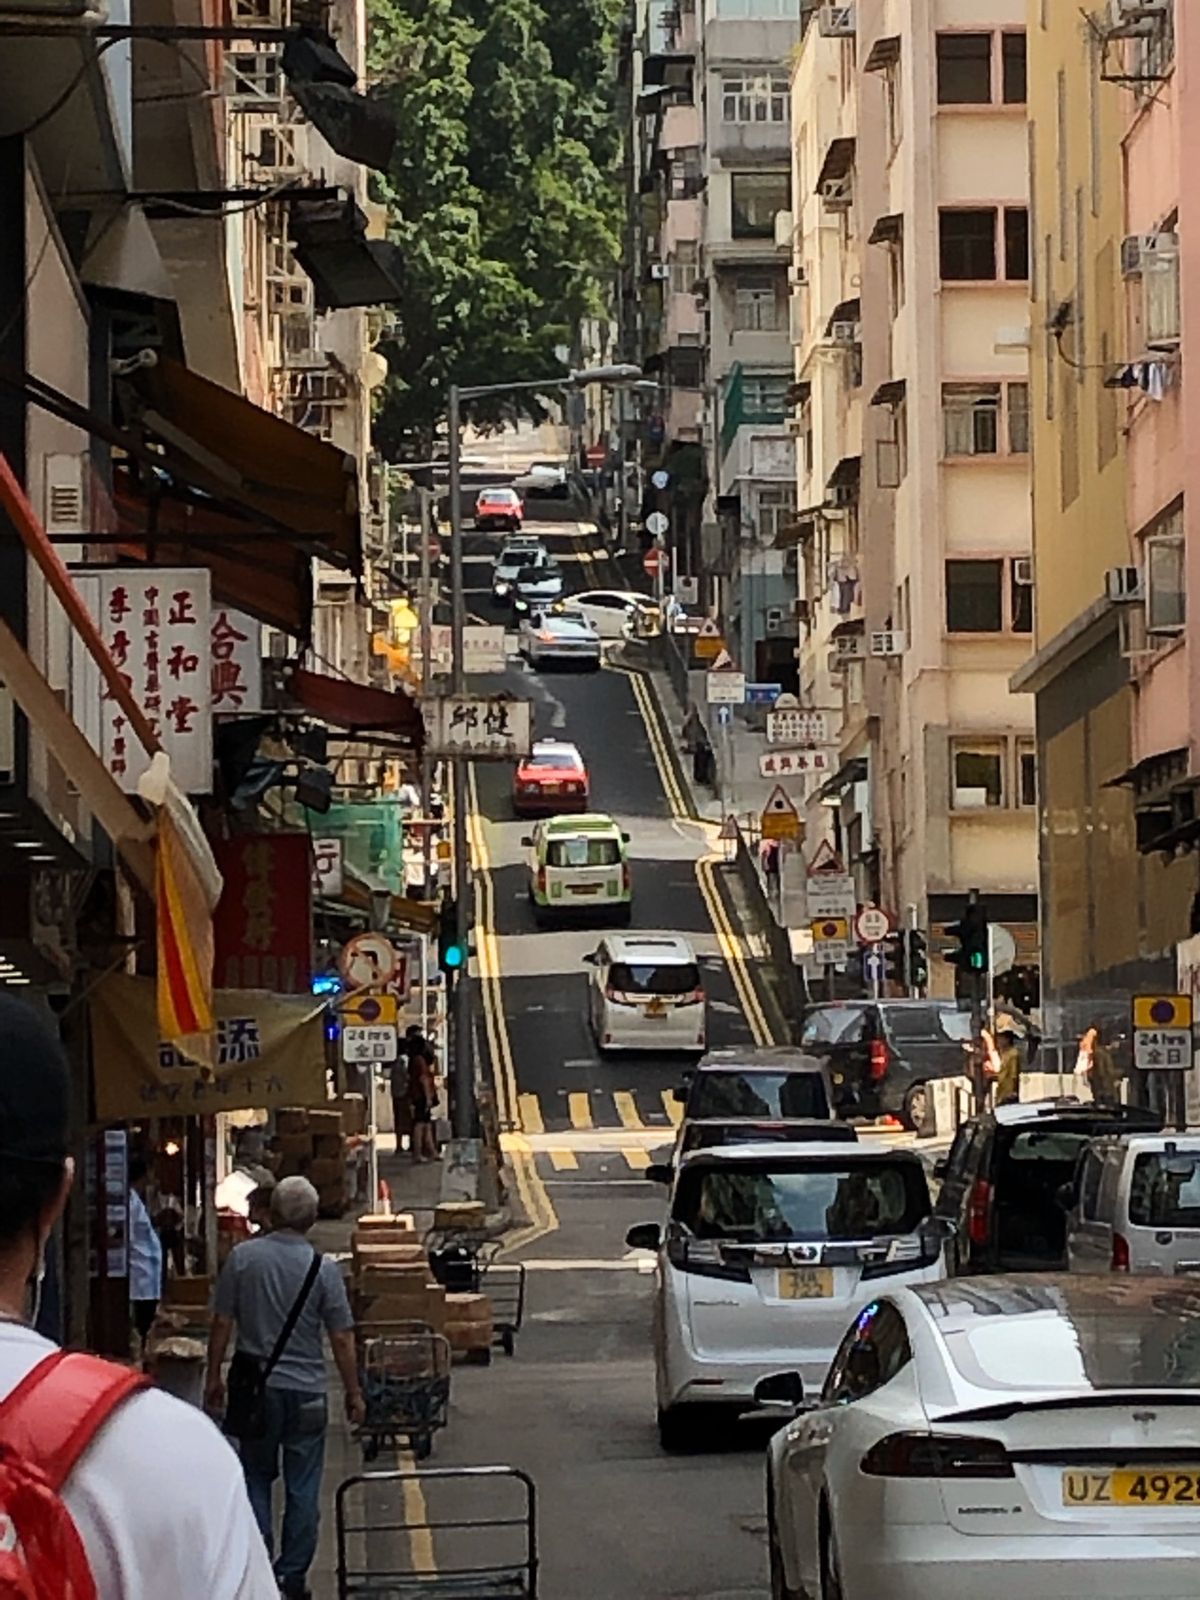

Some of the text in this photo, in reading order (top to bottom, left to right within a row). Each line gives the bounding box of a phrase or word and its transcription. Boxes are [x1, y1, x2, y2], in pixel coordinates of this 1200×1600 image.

[166, 591, 199, 733] 正和堂
[1147, 1048, 1181, 1065] 全日
[1067, 1474, 1200, 1502] UZ 492
